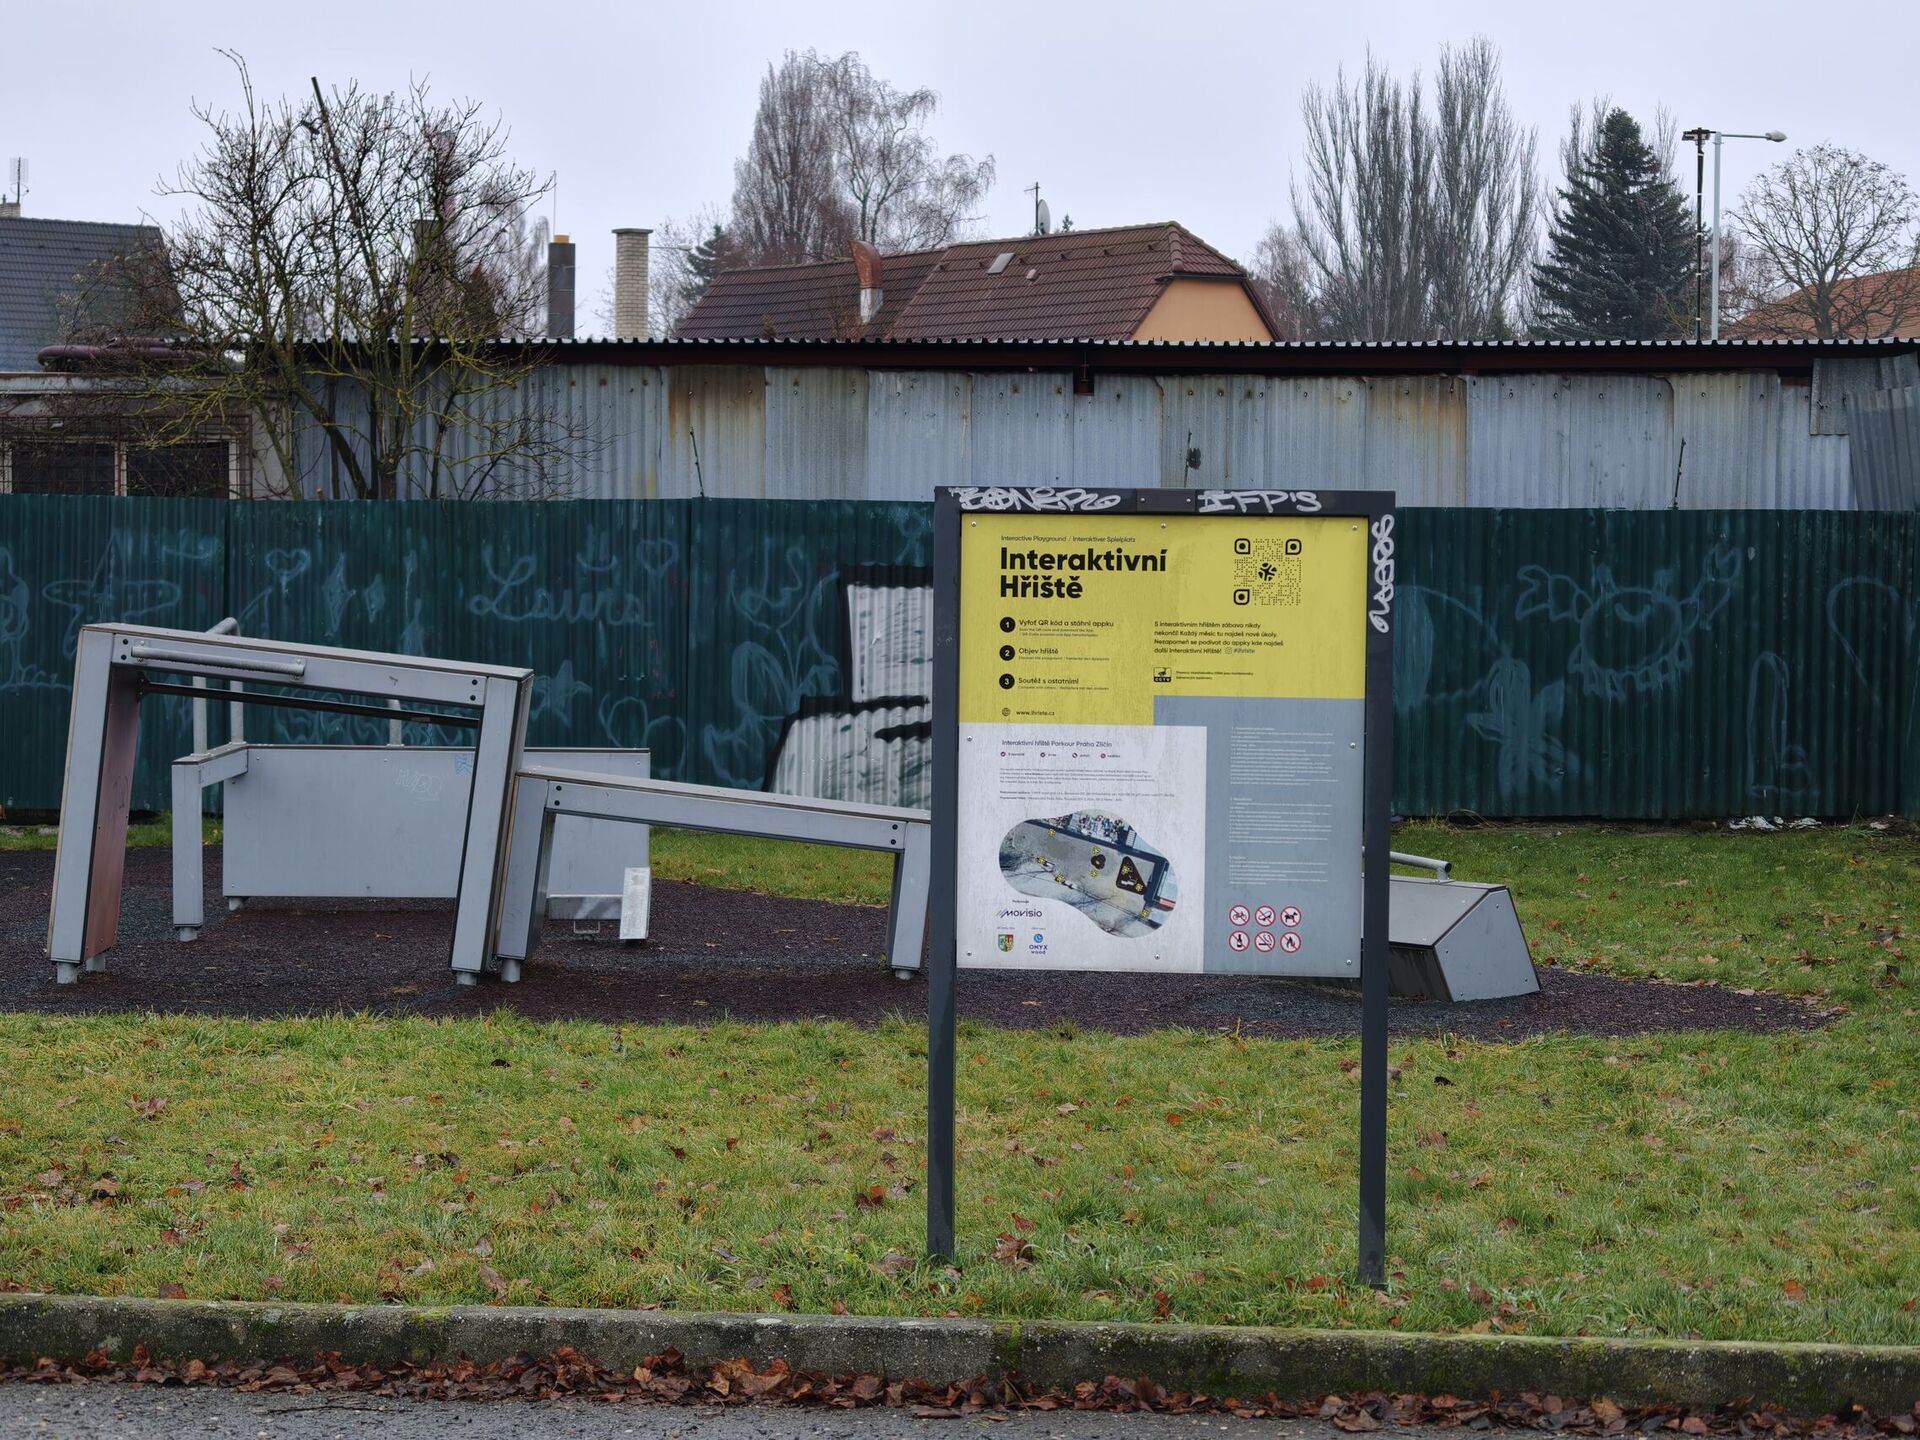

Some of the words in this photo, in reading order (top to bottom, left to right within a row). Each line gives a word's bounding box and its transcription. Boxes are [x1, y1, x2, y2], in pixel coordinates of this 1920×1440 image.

[1001, 547, 1168, 571] Interaktivní
[1000, 574, 1083, 599] Hřiště
[1004, 649, 1010, 657] 2
[1004, 677, 1010, 685] 3
[1051, 740, 1075, 748] Parkour
